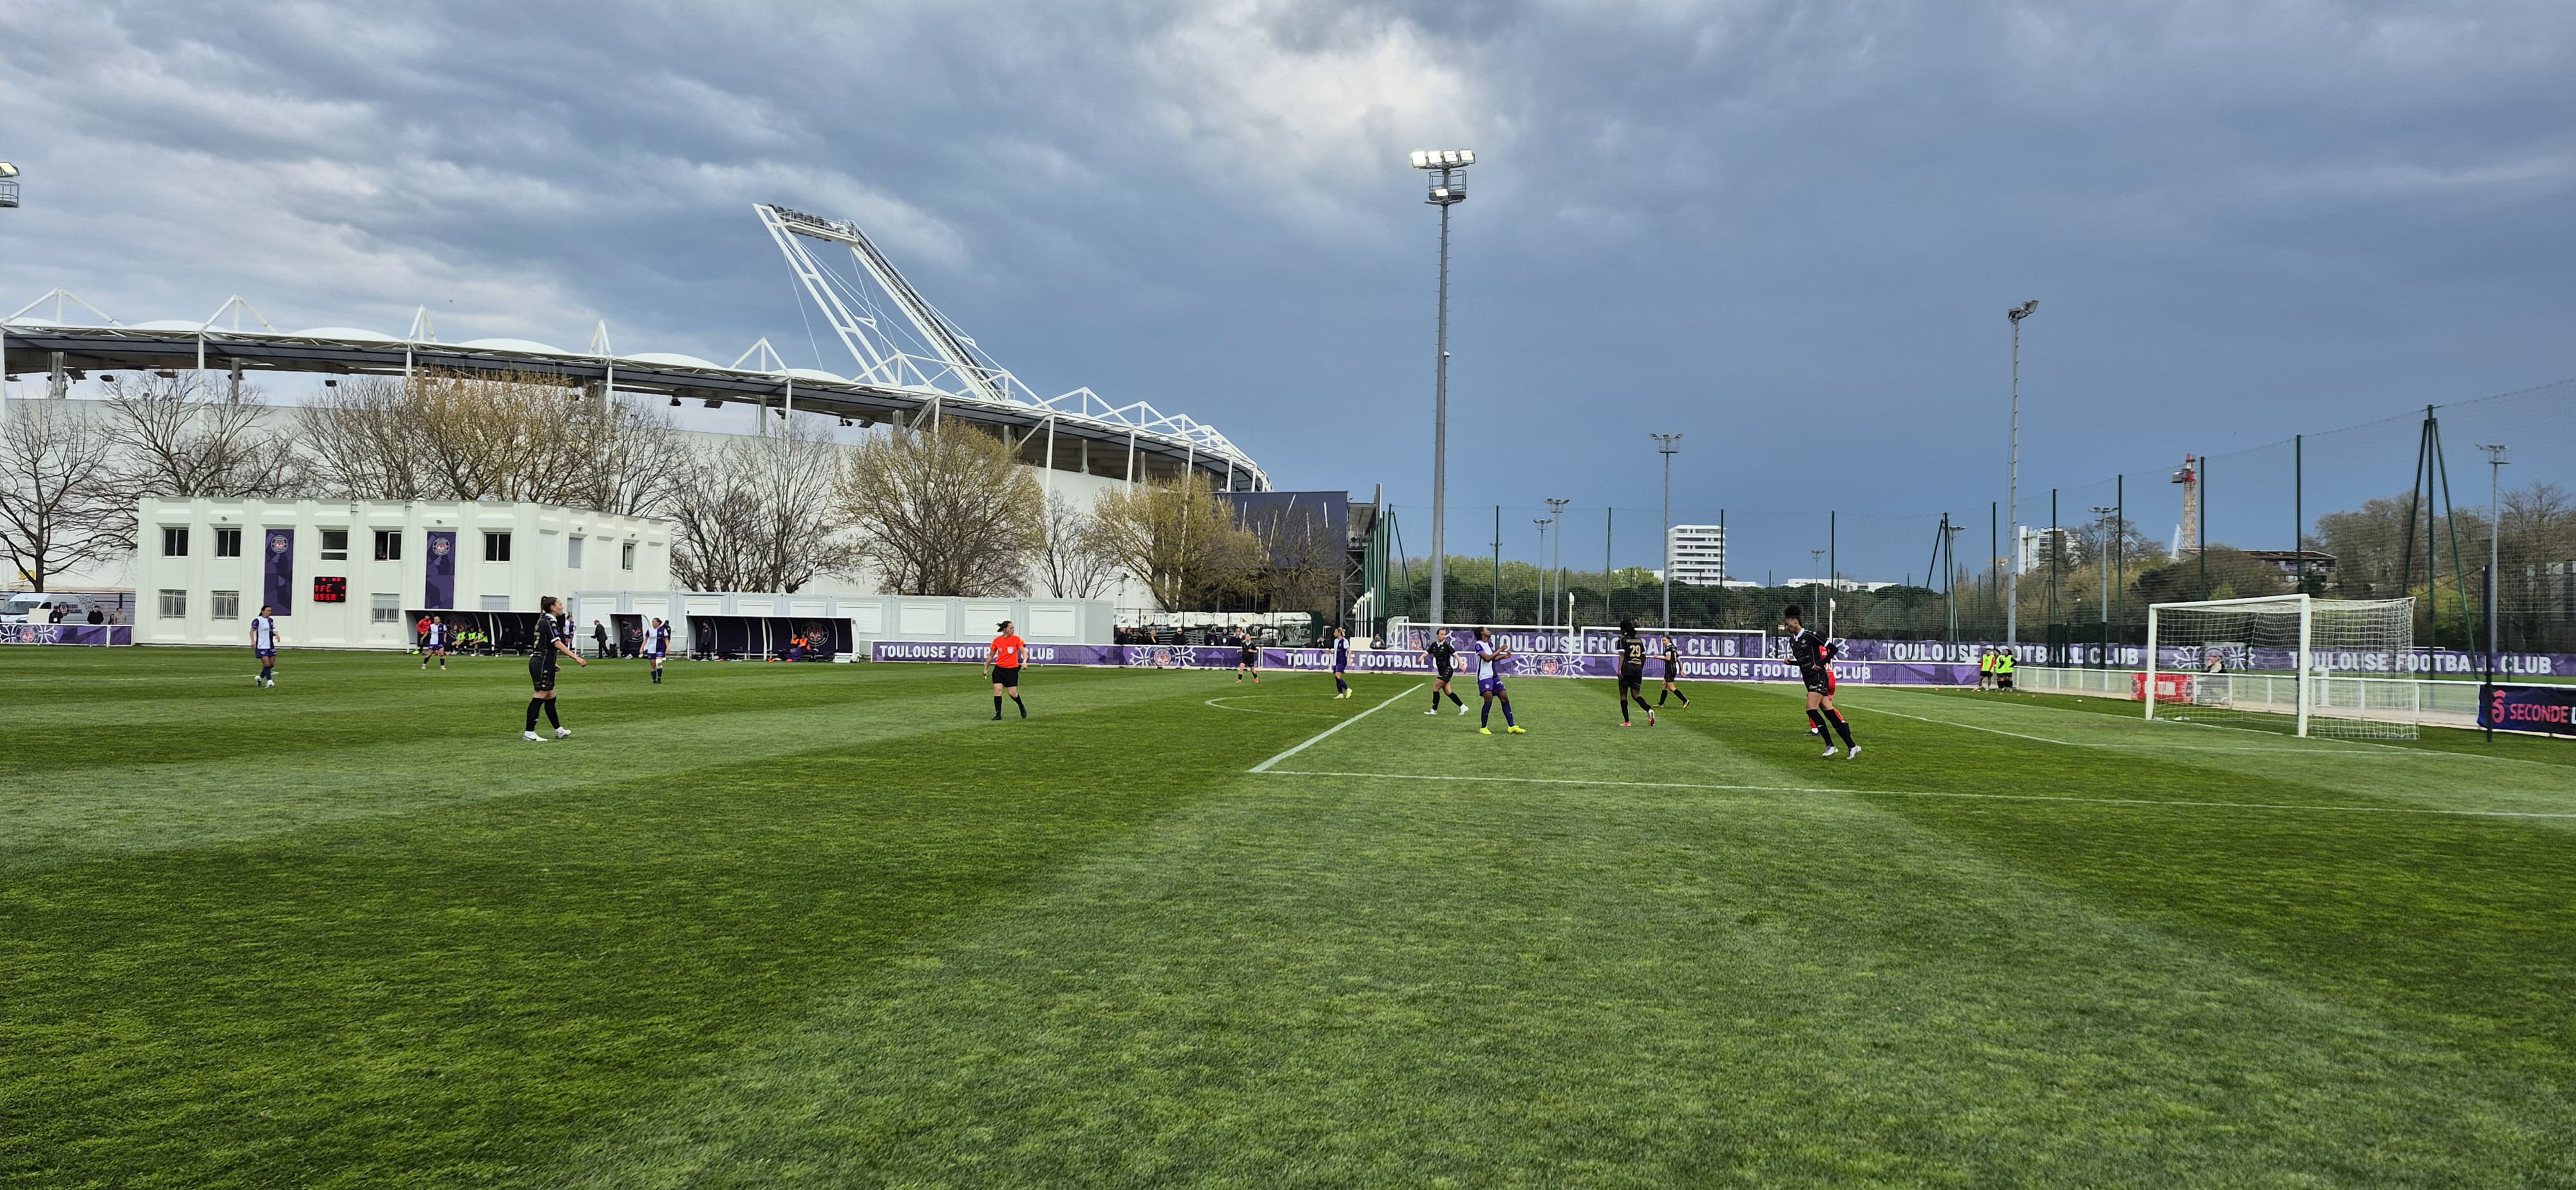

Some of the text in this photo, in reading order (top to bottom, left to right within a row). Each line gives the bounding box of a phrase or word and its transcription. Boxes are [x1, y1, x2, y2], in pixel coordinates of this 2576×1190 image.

[880, 645, 1054, 660] TOULOUSE FOOTB LUB
[1587, 636, 1682, 655] FOOAL
[1687, 638, 1735, 656] CLUB
[1630, 645, 1641, 657] 29
[1882, 643, 1980, 662] TOULOUSE
[2090, 647, 2139, 665] CLUB
[1286, 653, 1468, 669] TOULOE FOOTBALL CUB
[2289, 651, 2389, 671] TULOUSE
[2501, 656, 2552, 674] CLUB
[1754, 664, 1803, 677] FOOTB
[1833, 666, 1871, 680] CLUB
[2510, 703, 2569, 723] SECONDE
